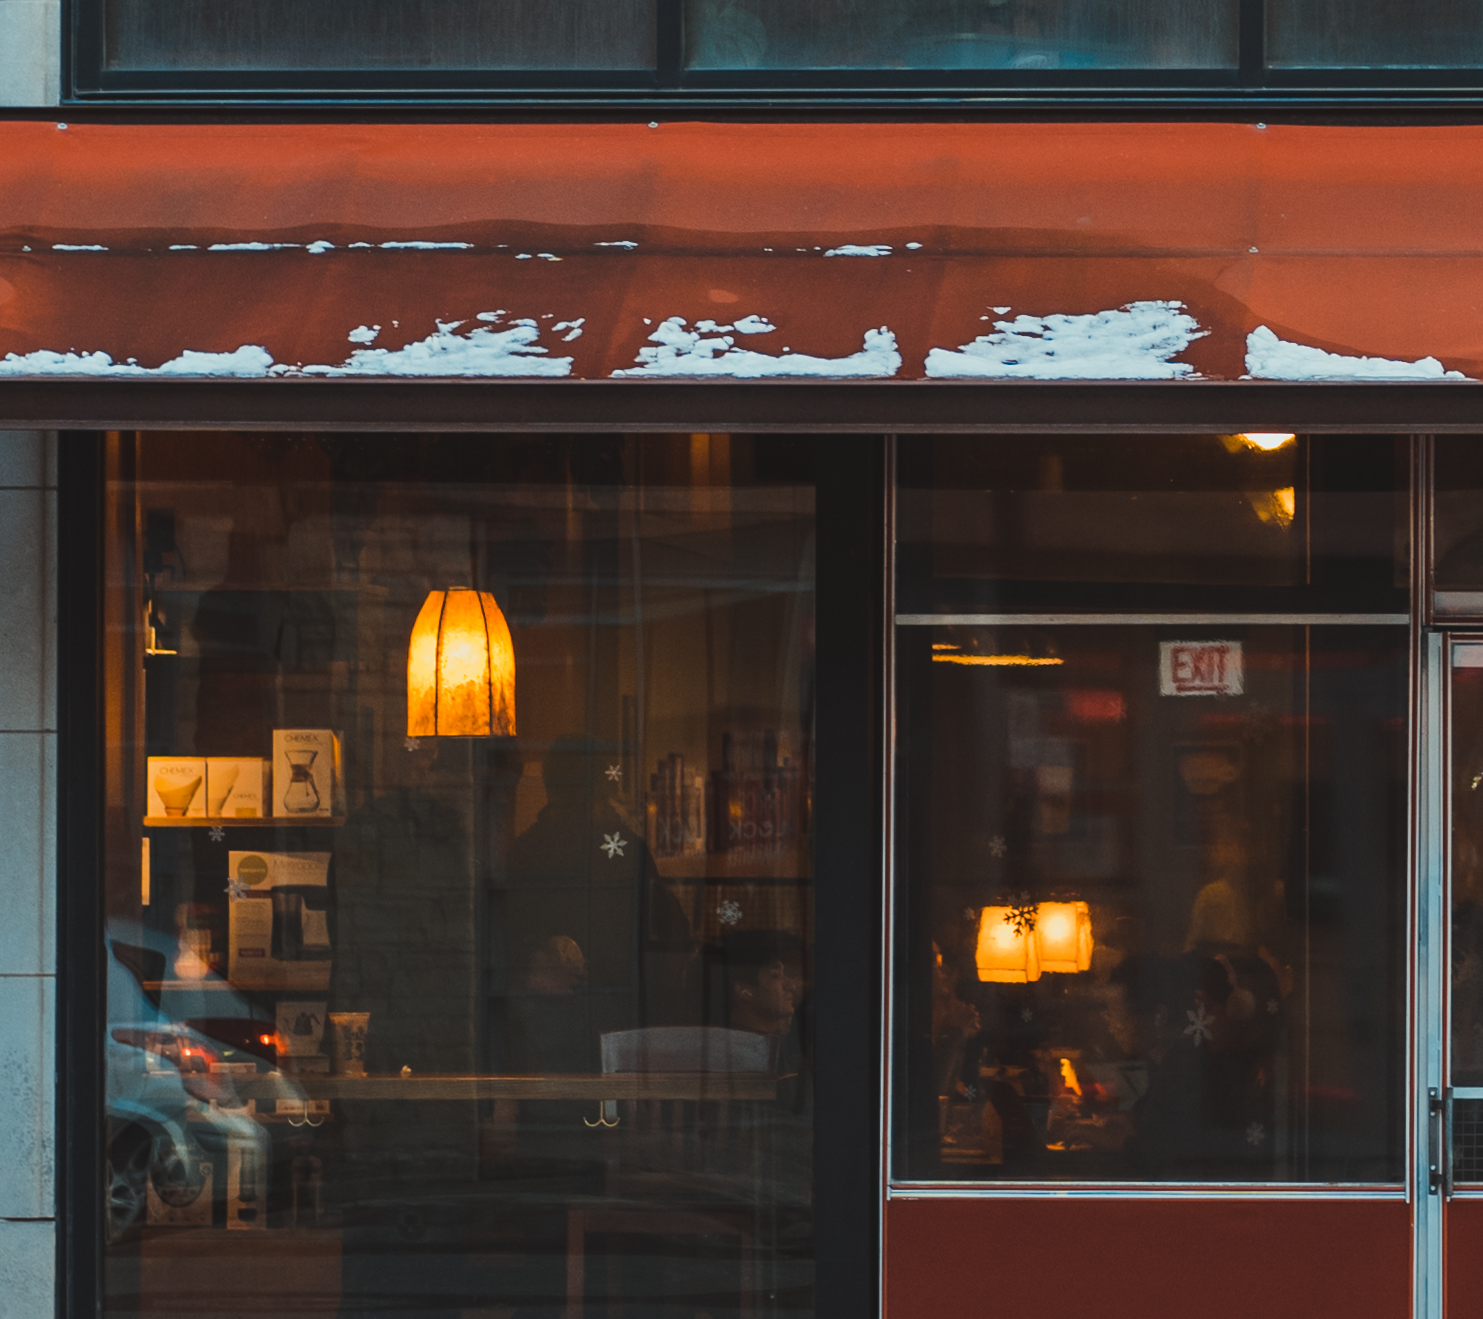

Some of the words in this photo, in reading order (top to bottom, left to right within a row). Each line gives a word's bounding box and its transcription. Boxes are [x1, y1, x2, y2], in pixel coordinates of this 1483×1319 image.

[1170, 645, 1230, 684] EXIT
[285, 734, 319, 742] CHEMEX
[159, 766, 195, 775] CHEMEX
